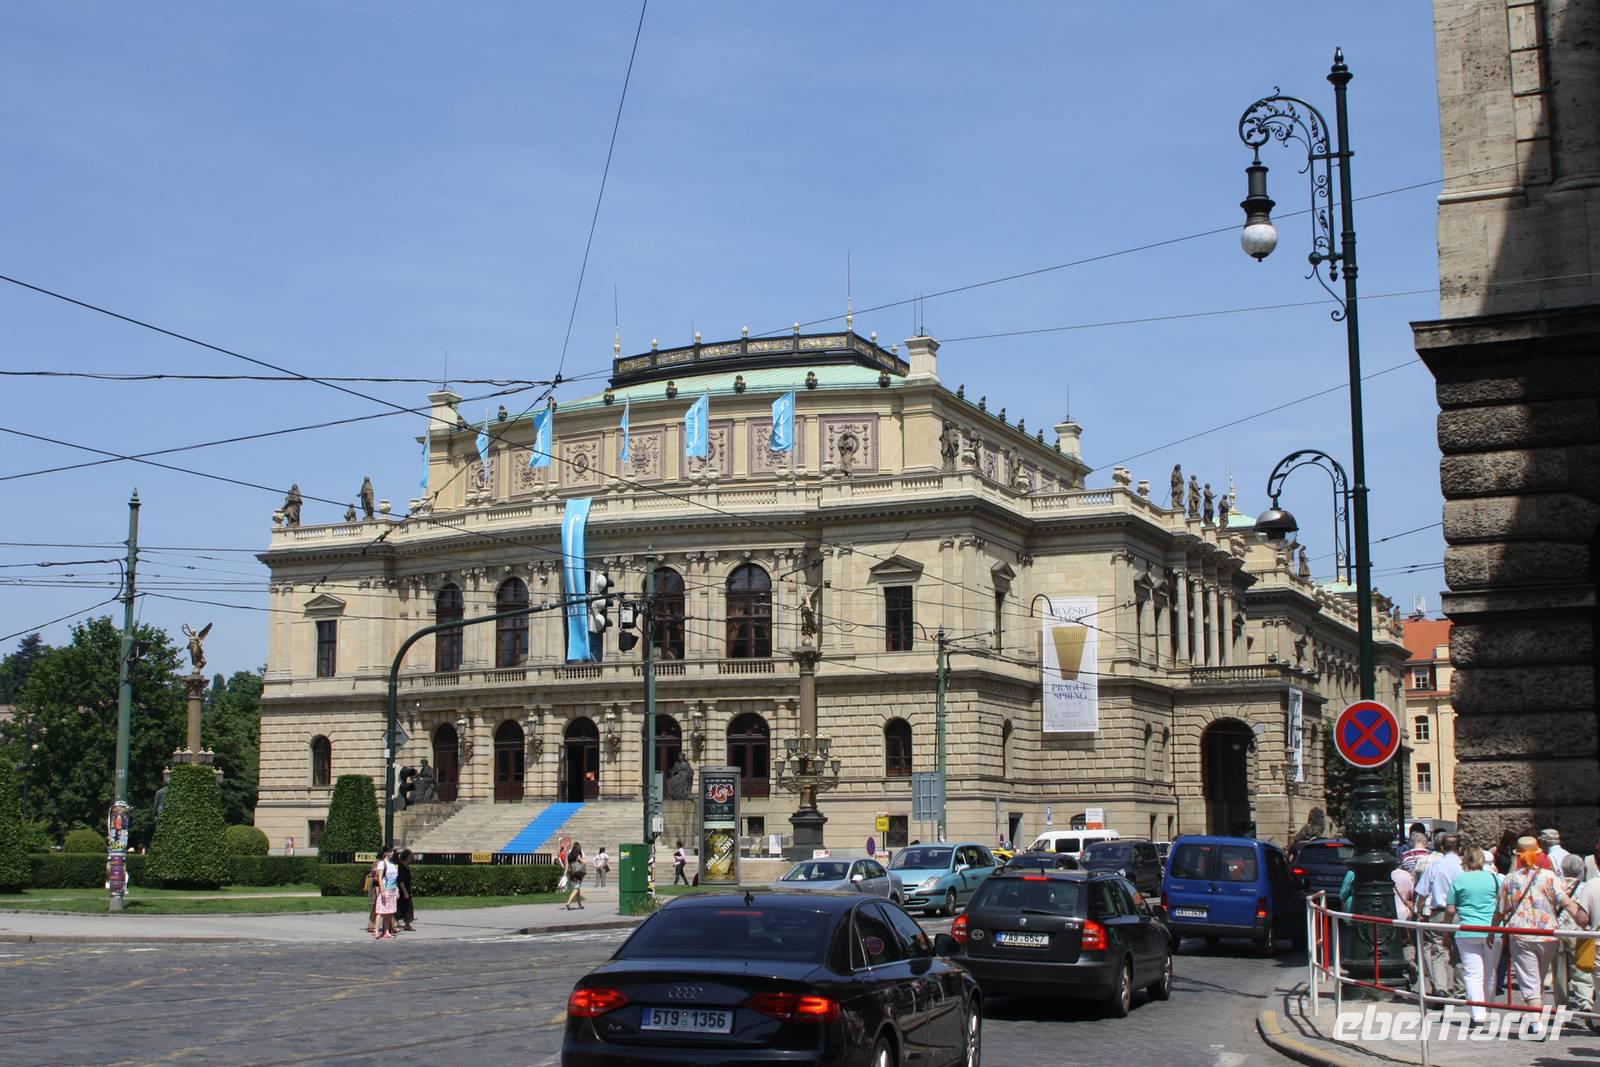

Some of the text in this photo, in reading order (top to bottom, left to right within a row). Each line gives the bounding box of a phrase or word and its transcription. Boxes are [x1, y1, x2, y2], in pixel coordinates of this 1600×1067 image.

[1054, 692, 1087, 700] SPRING
[720, 837, 734, 853] 2015
[653, 1009, 727, 1028] 5T9 1356
